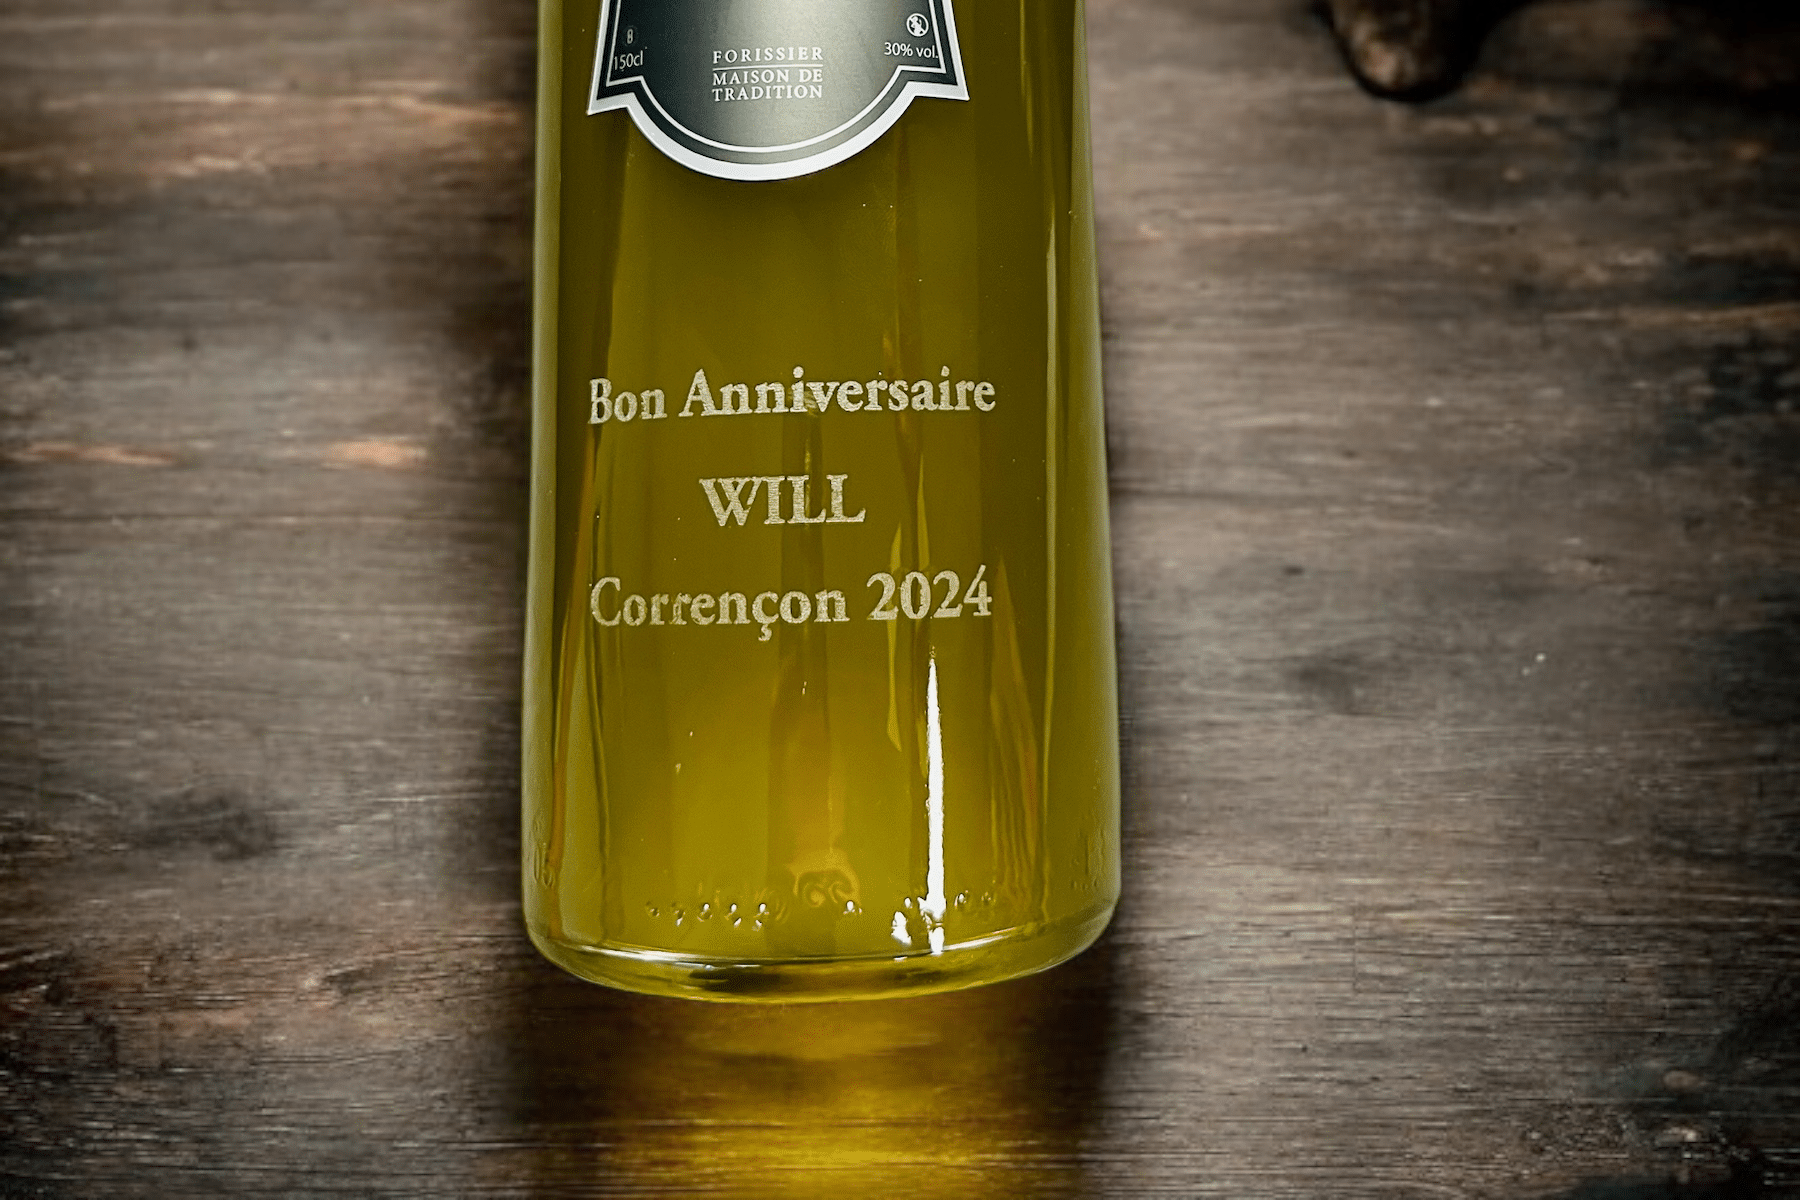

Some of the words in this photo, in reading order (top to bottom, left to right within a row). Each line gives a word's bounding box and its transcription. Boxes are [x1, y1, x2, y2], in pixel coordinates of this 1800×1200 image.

[712, 46, 824, 64] FORISSIER
[884, 42, 913, 57] 30%
[915, 45, 939, 59] vol.
[613, 50, 644, 71] 150cl
[712, 69, 790, 86] MAISON
[799, 68, 823, 83] DE
[711, 84, 823, 102] TRADITION
[588, 377, 668, 425] Bon
[678, 365, 997, 417] Anniversaire
[699, 474, 866, 527] WILL
[589, 576, 851, 642] Corrençon
[866, 563, 994, 622] 2024
